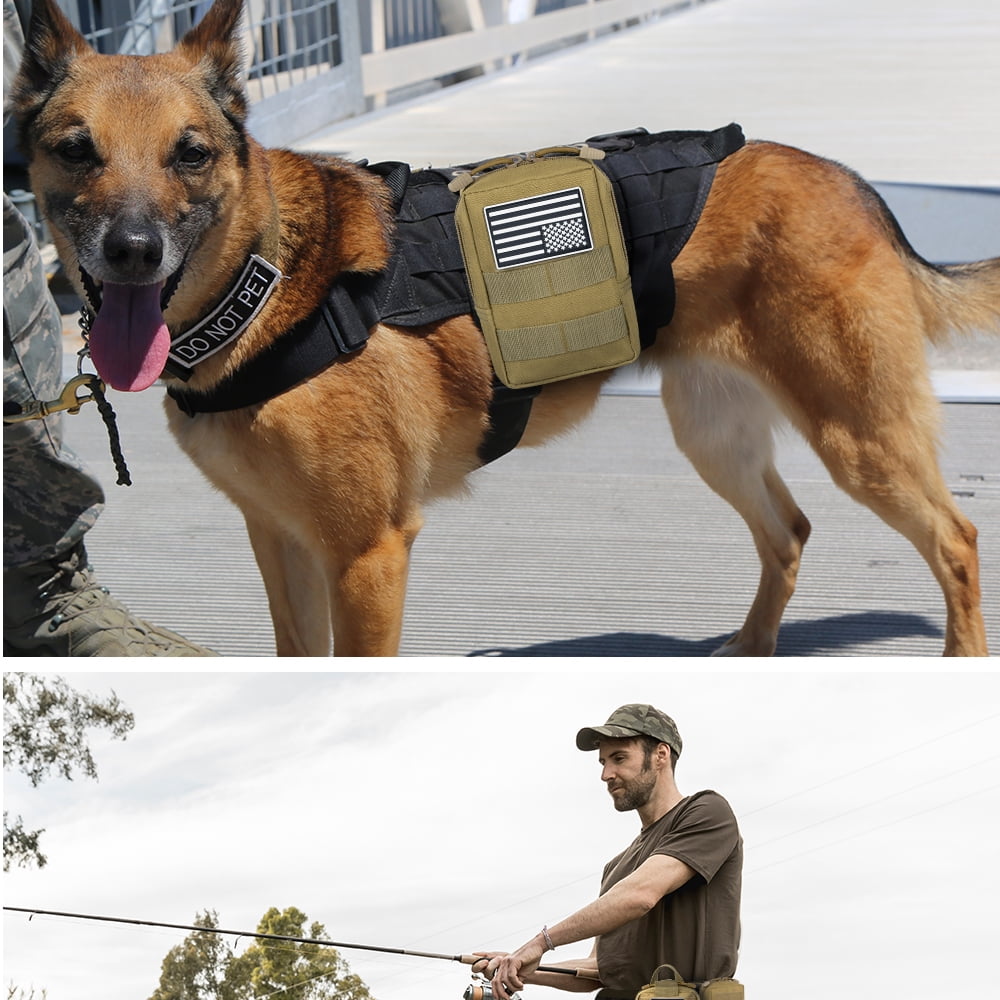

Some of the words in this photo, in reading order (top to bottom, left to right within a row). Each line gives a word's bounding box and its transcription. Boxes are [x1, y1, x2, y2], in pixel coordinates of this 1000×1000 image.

[175, 337, 210, 359] DO
[204, 305, 243, 341] NOT
[237, 266, 268, 308] PET
